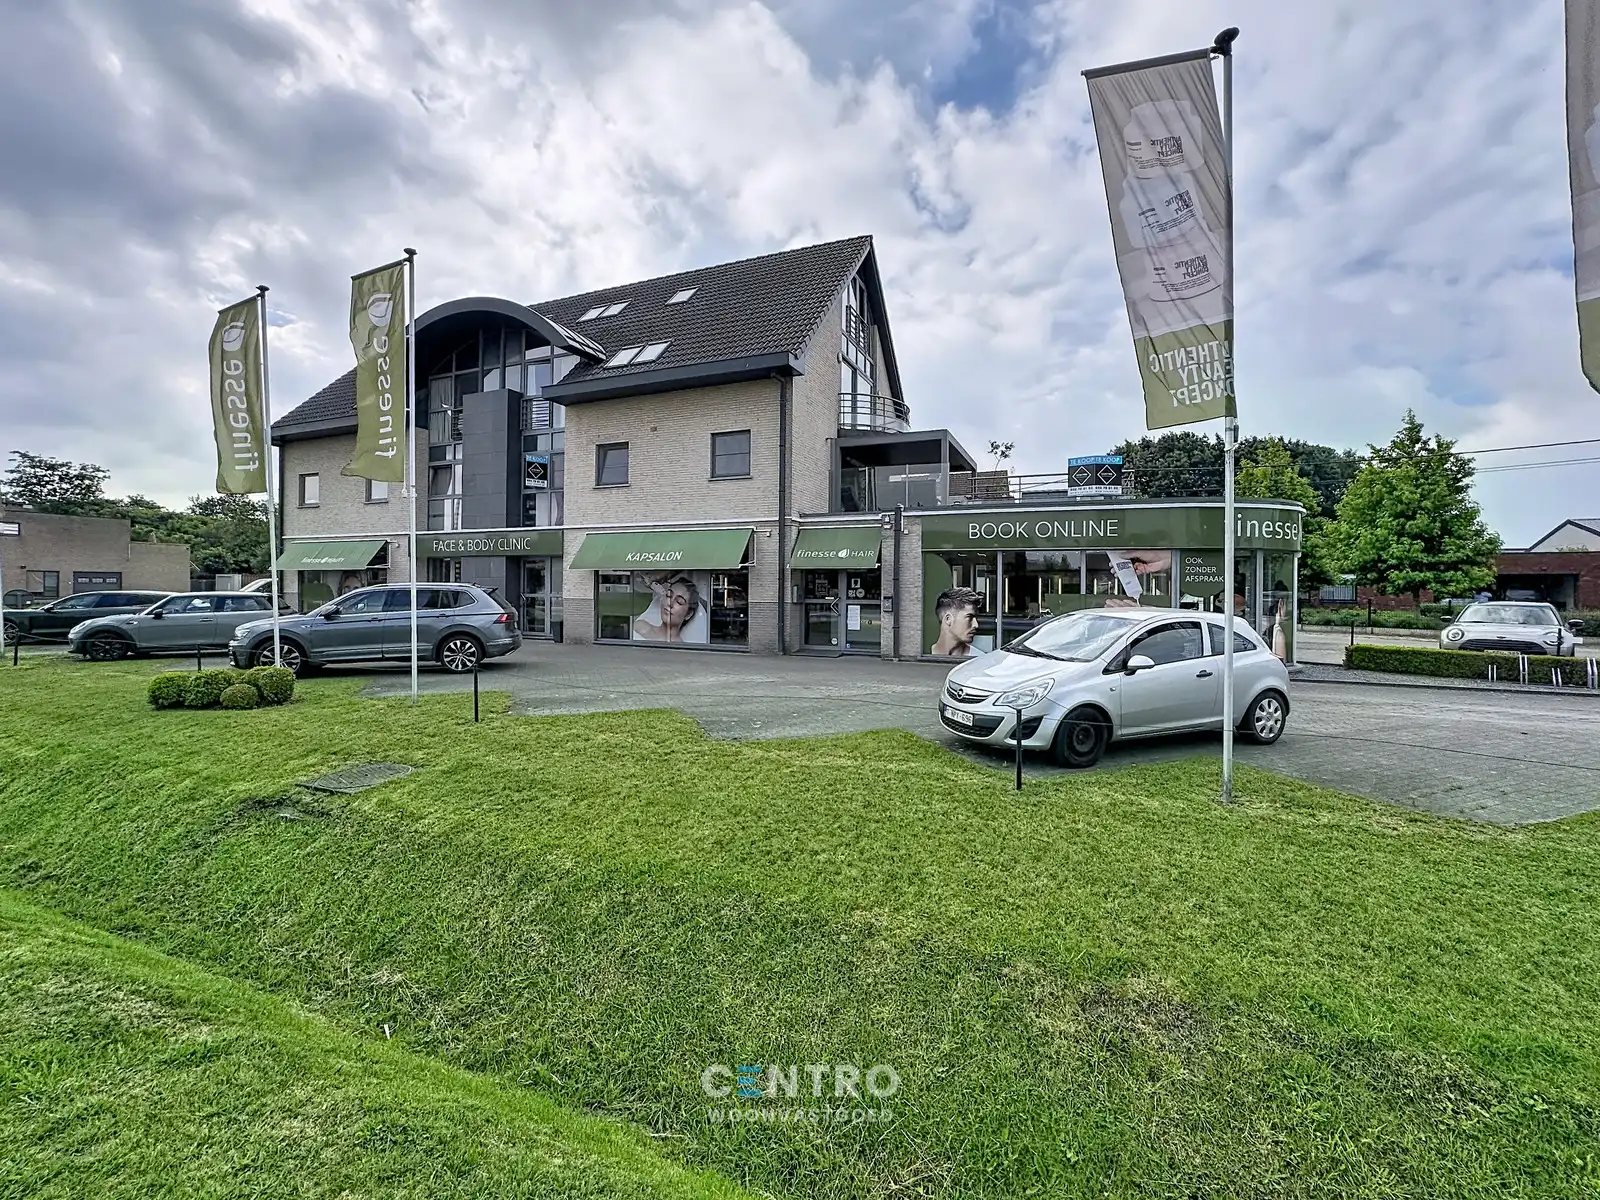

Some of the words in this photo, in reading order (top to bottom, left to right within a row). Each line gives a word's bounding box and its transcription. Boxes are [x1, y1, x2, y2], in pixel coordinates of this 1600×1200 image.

[968, 521, 1029, 539] BOOK
[1035, 519, 1119, 538] ONLINE
[1237, 513, 1298, 540] inesse
[433, 540, 456, 552] FACE
[458, 539, 465, 551] &
[467, 539, 496, 551] BODY
[498, 537, 531, 550] CLINIC
[625, 550, 683, 562] KAPSALON
[797, 549, 836, 558] finesse
